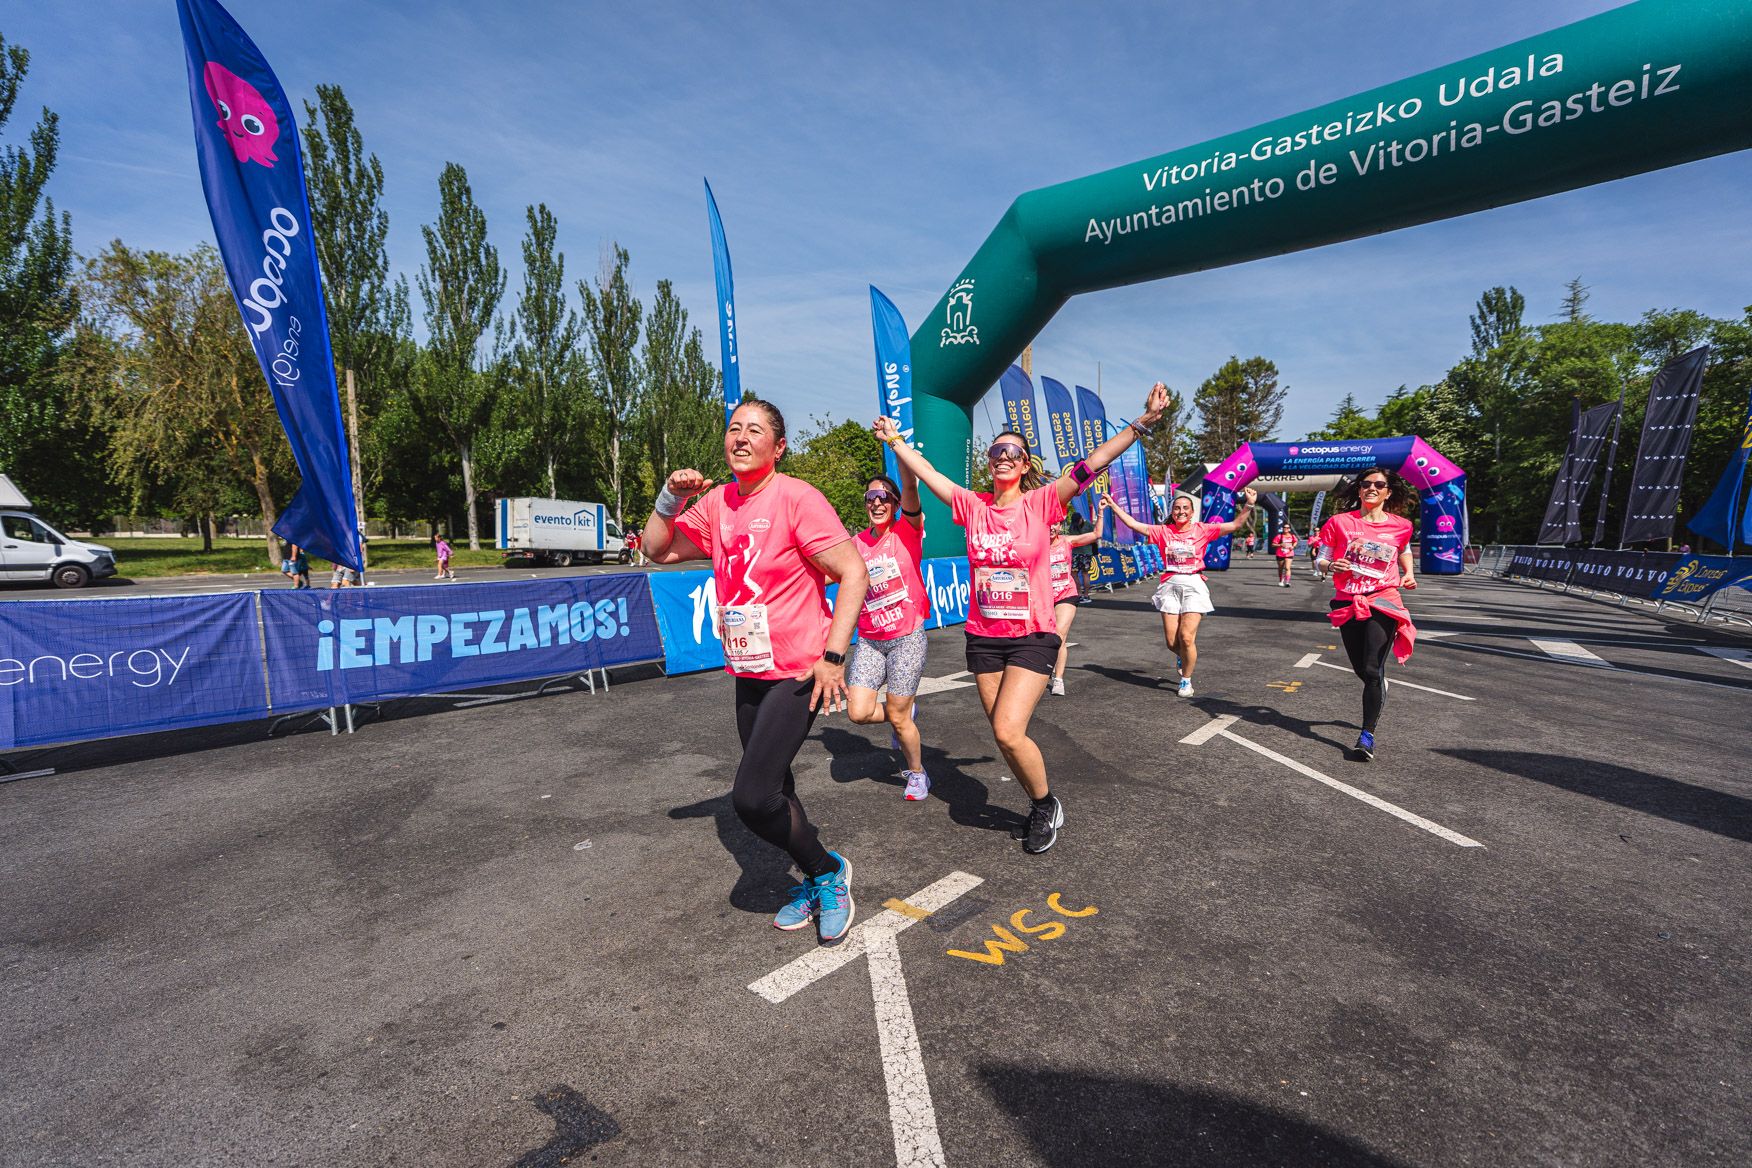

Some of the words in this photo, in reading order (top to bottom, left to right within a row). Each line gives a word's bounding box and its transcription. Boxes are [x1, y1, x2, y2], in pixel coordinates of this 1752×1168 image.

[1142, 94, 1423, 192] Vitoria-Gasteizko
[1438, 52, 1564, 107] Udala
[1085, 177, 1284, 245] Ayuntamiento
[1295, 158, 1338, 191] de
[1349, 62, 1683, 177] Vitoria-Gasteiz
[1293, 456, 1324, 464] ENERGÍA
[534, 514, 572, 526] evento
[578, 515, 592, 527] kit
[1535, 559, 1570, 570] VOLVO
[1576, 562, 1611, 576] VOLVO
[1617, 566, 1668, 583] VOLVO
[873, 582, 889, 593] 016
[991, 591, 1013, 600] 016
[871, 606, 904, 628] MUJER
[316, 597, 630, 671] ¡EMPEZAMOS!
[0, 646, 190, 688] energy
[946, 892, 1099, 965] WSC
